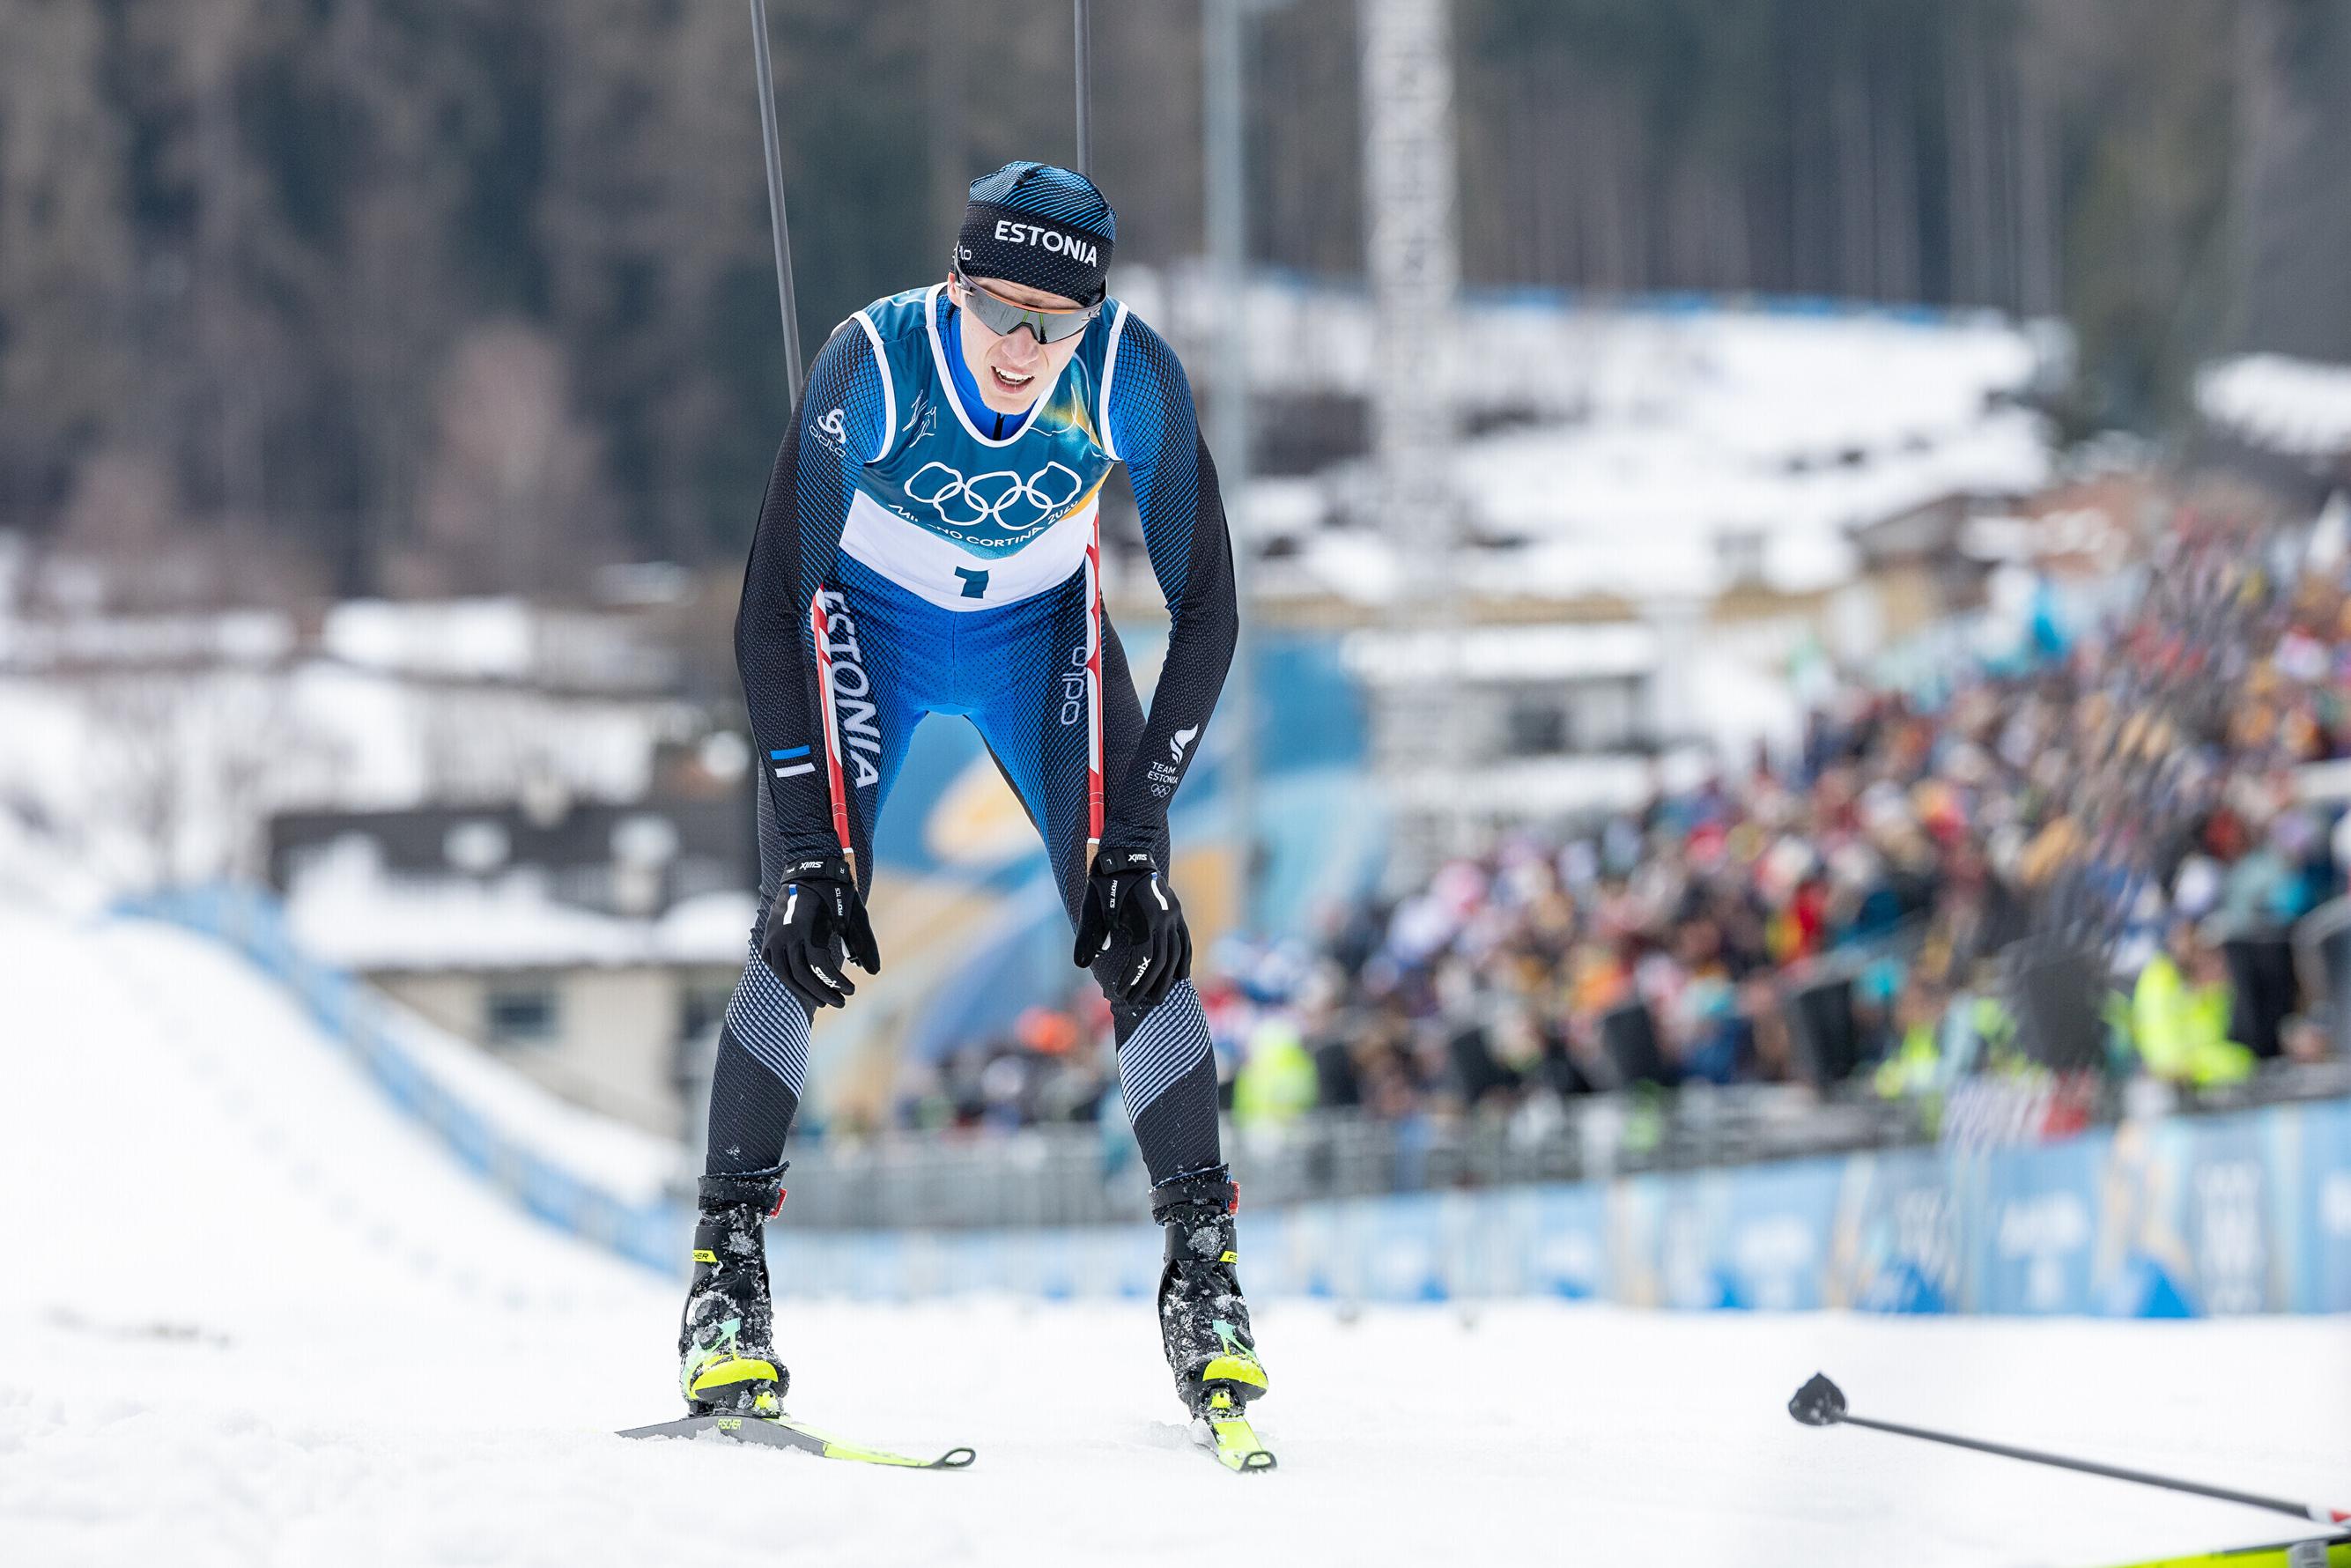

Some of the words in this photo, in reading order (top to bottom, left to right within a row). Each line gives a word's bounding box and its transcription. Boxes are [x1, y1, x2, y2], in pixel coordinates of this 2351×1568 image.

[994, 219, 1098, 268] ESTONIA
[966, 526, 1046, 547] CORTINA
[824, 591, 882, 788] ESTONIA
[1061, 646, 1089, 726] odlo
[1147, 770, 1179, 784] ESTONIA
[1152, 761, 1177, 774] TEAM
